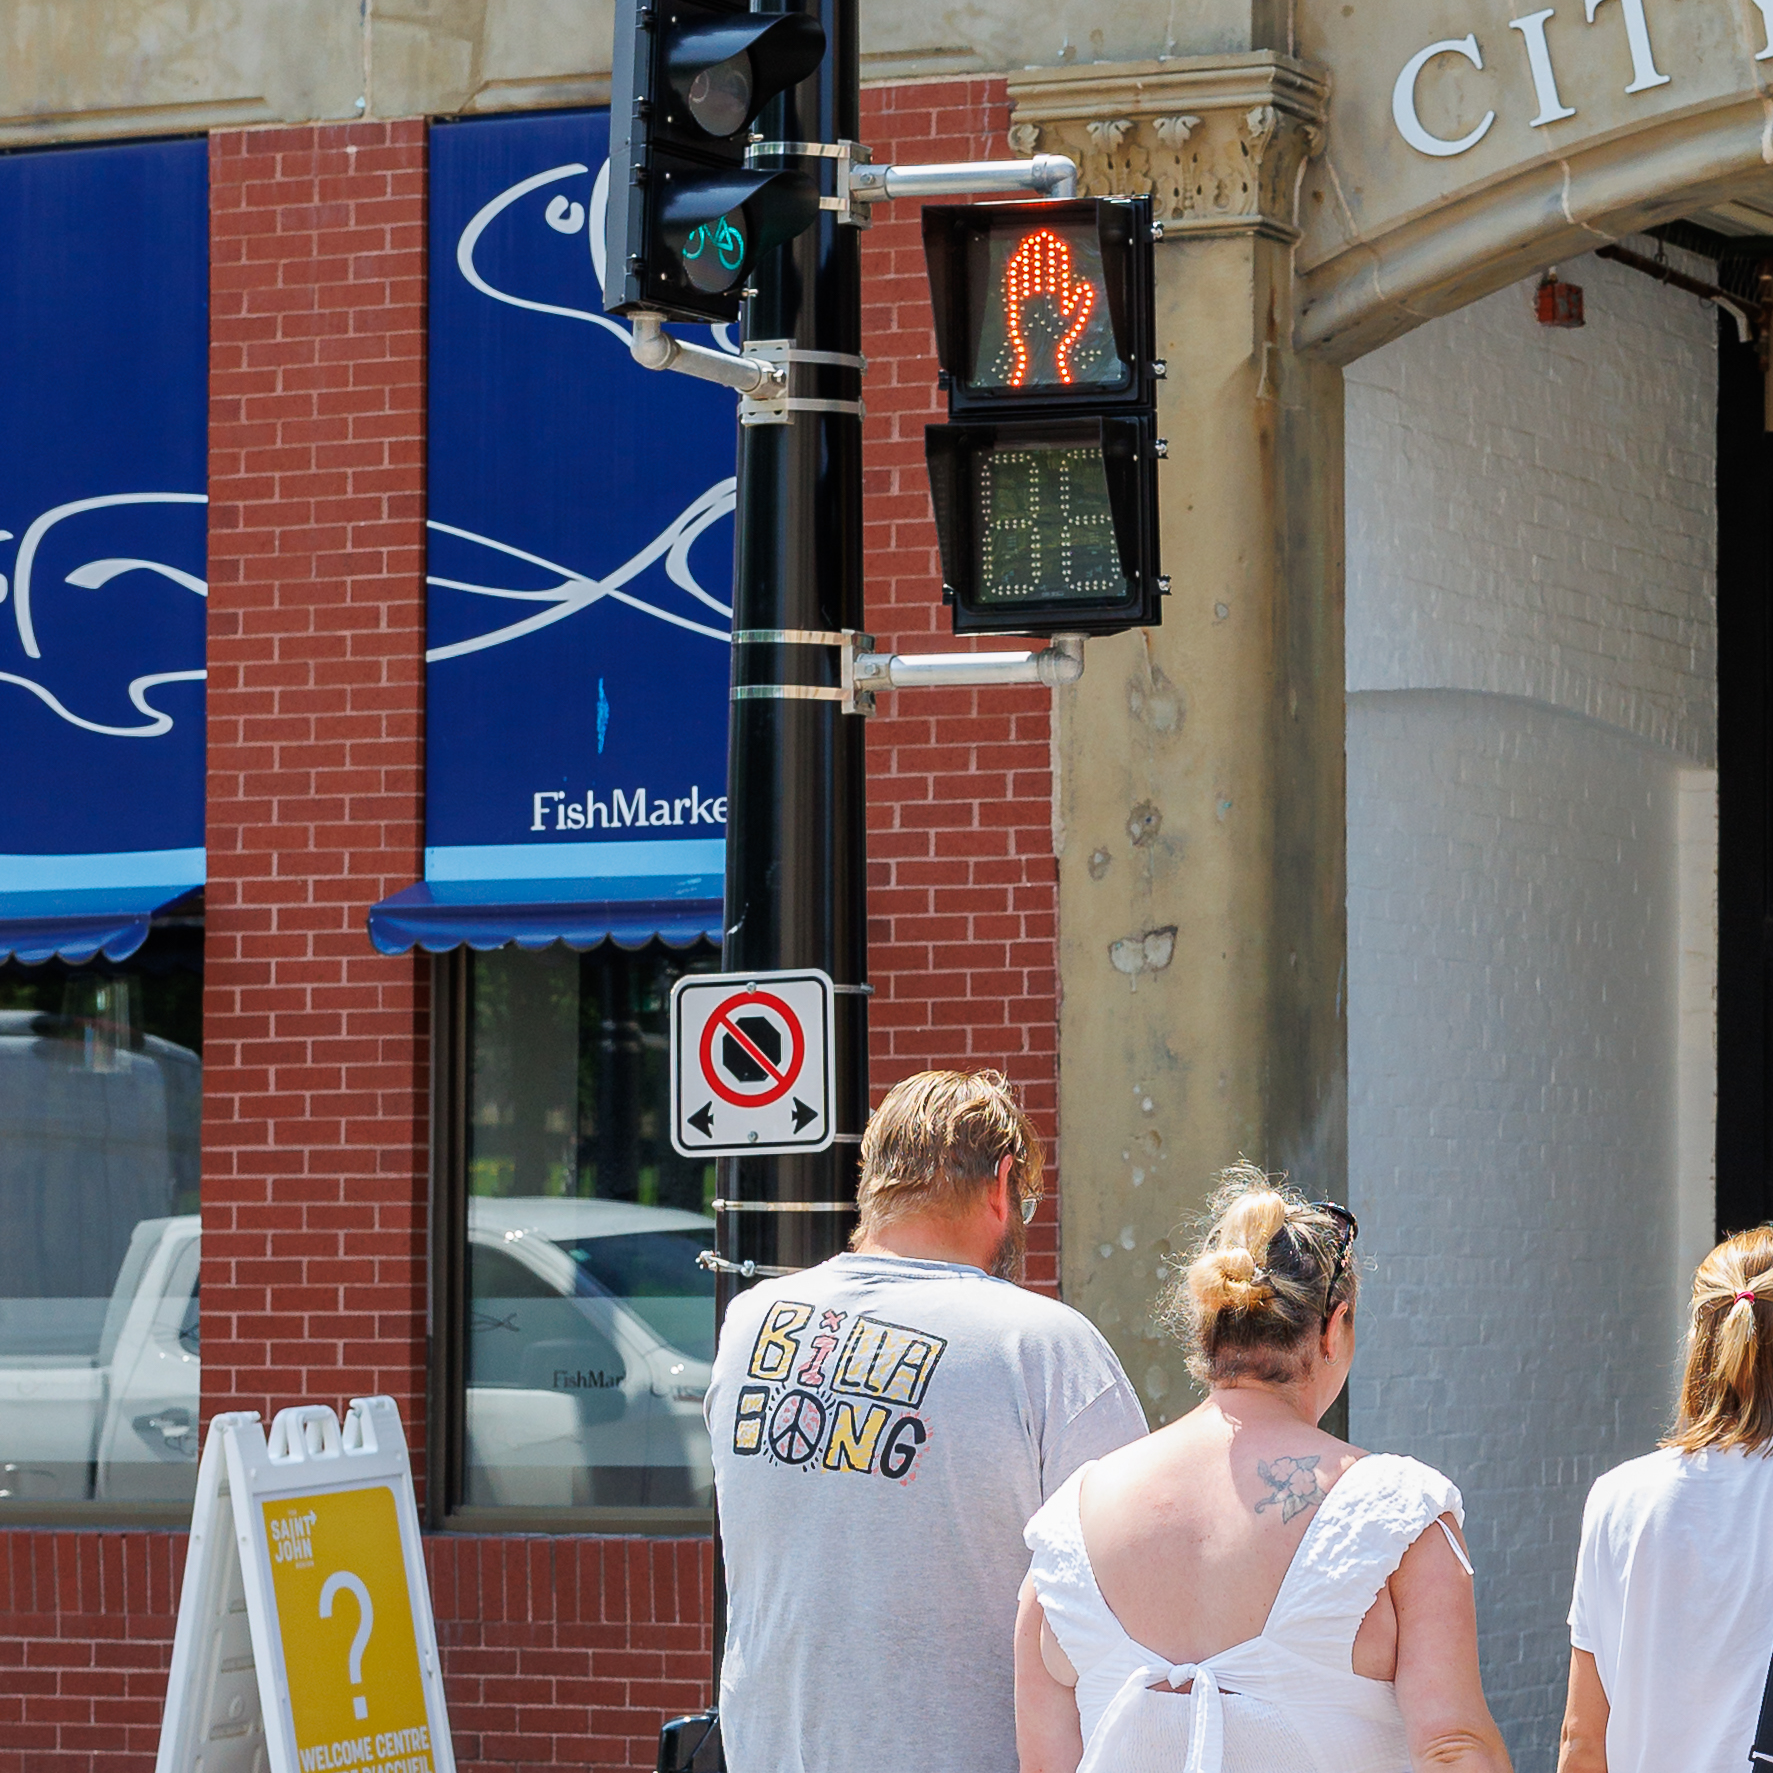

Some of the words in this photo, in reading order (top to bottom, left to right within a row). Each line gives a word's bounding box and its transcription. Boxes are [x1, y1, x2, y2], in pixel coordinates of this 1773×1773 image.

[270, 1510, 317, 1541] SAINT
[275, 1538, 313, 1564] JOHN
[300, 1736, 374, 1773] WELCOME
[375, 1725, 430, 1759] CENTRE
